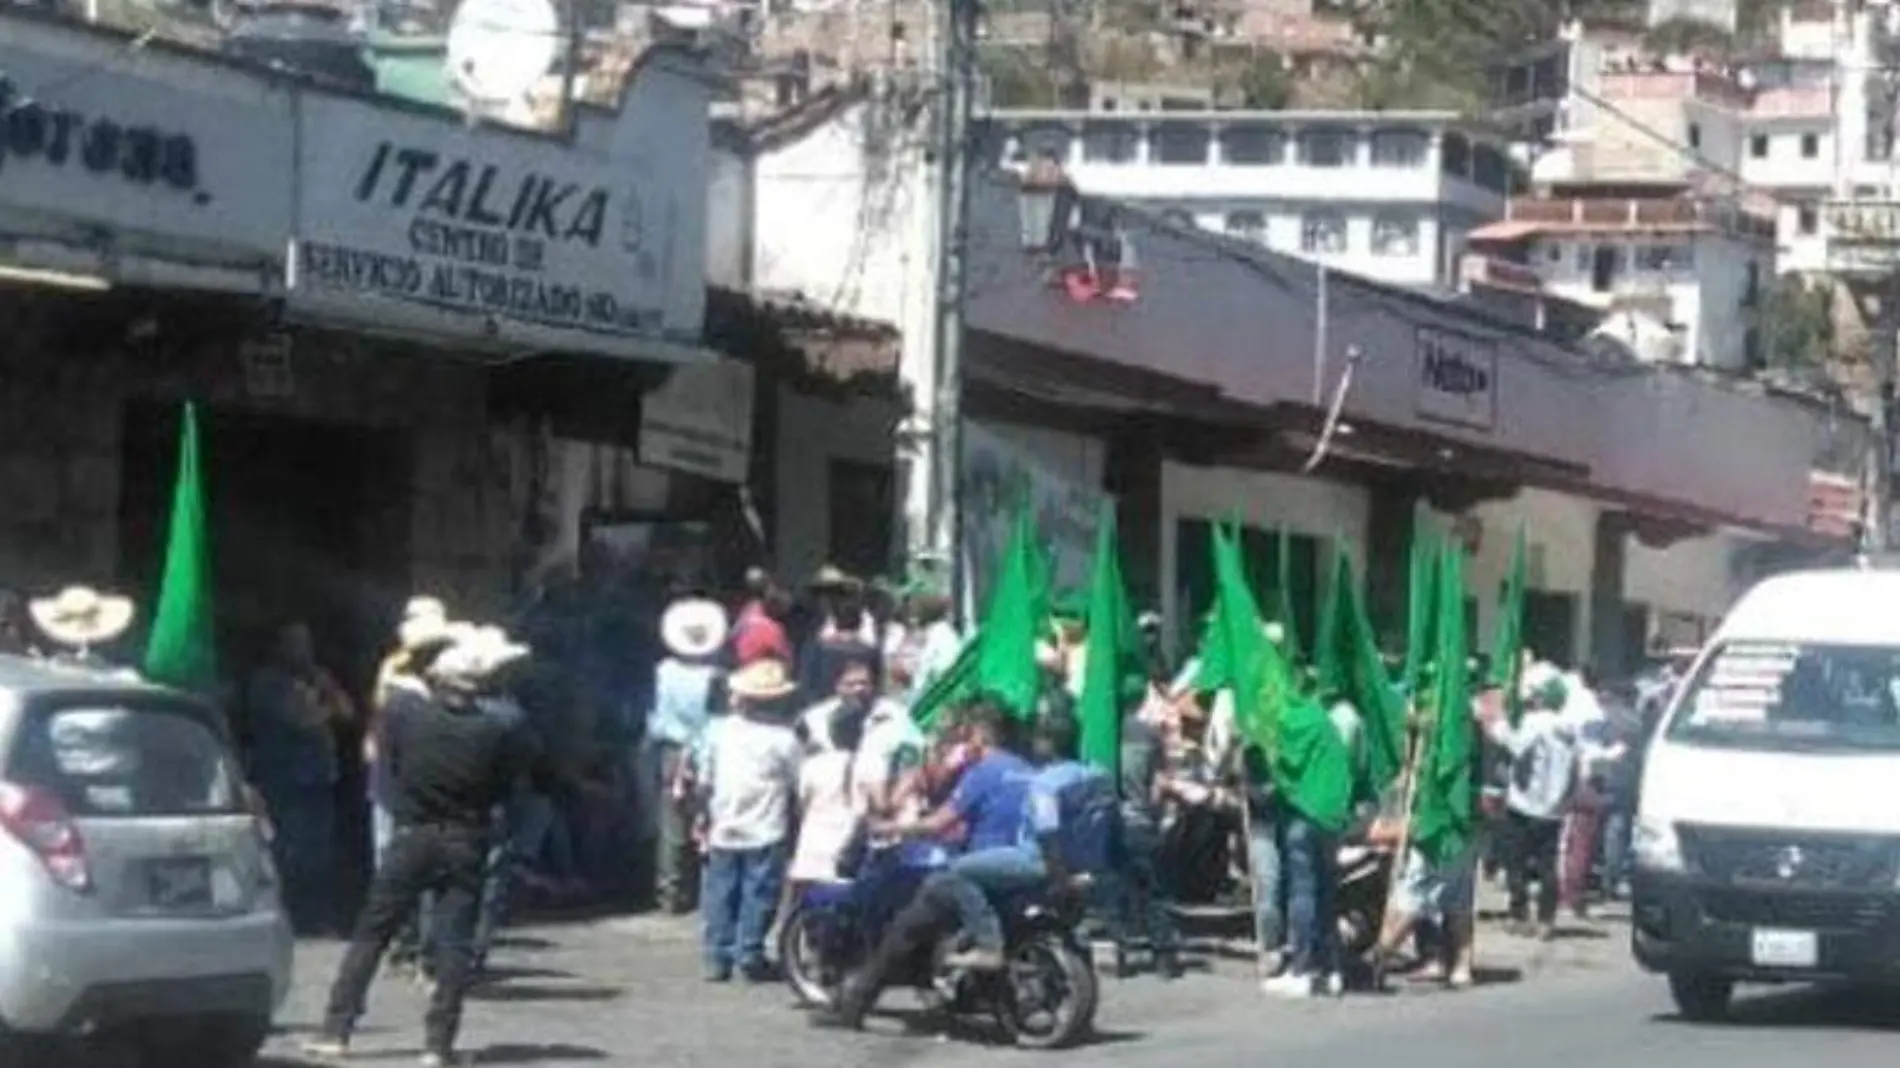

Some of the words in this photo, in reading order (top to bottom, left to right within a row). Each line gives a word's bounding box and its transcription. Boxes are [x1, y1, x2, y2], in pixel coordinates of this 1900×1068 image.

[354, 140, 609, 248] ITALIKA
[302, 240, 422, 293] SERVICIO
[408, 217, 508, 268] CENTRO
